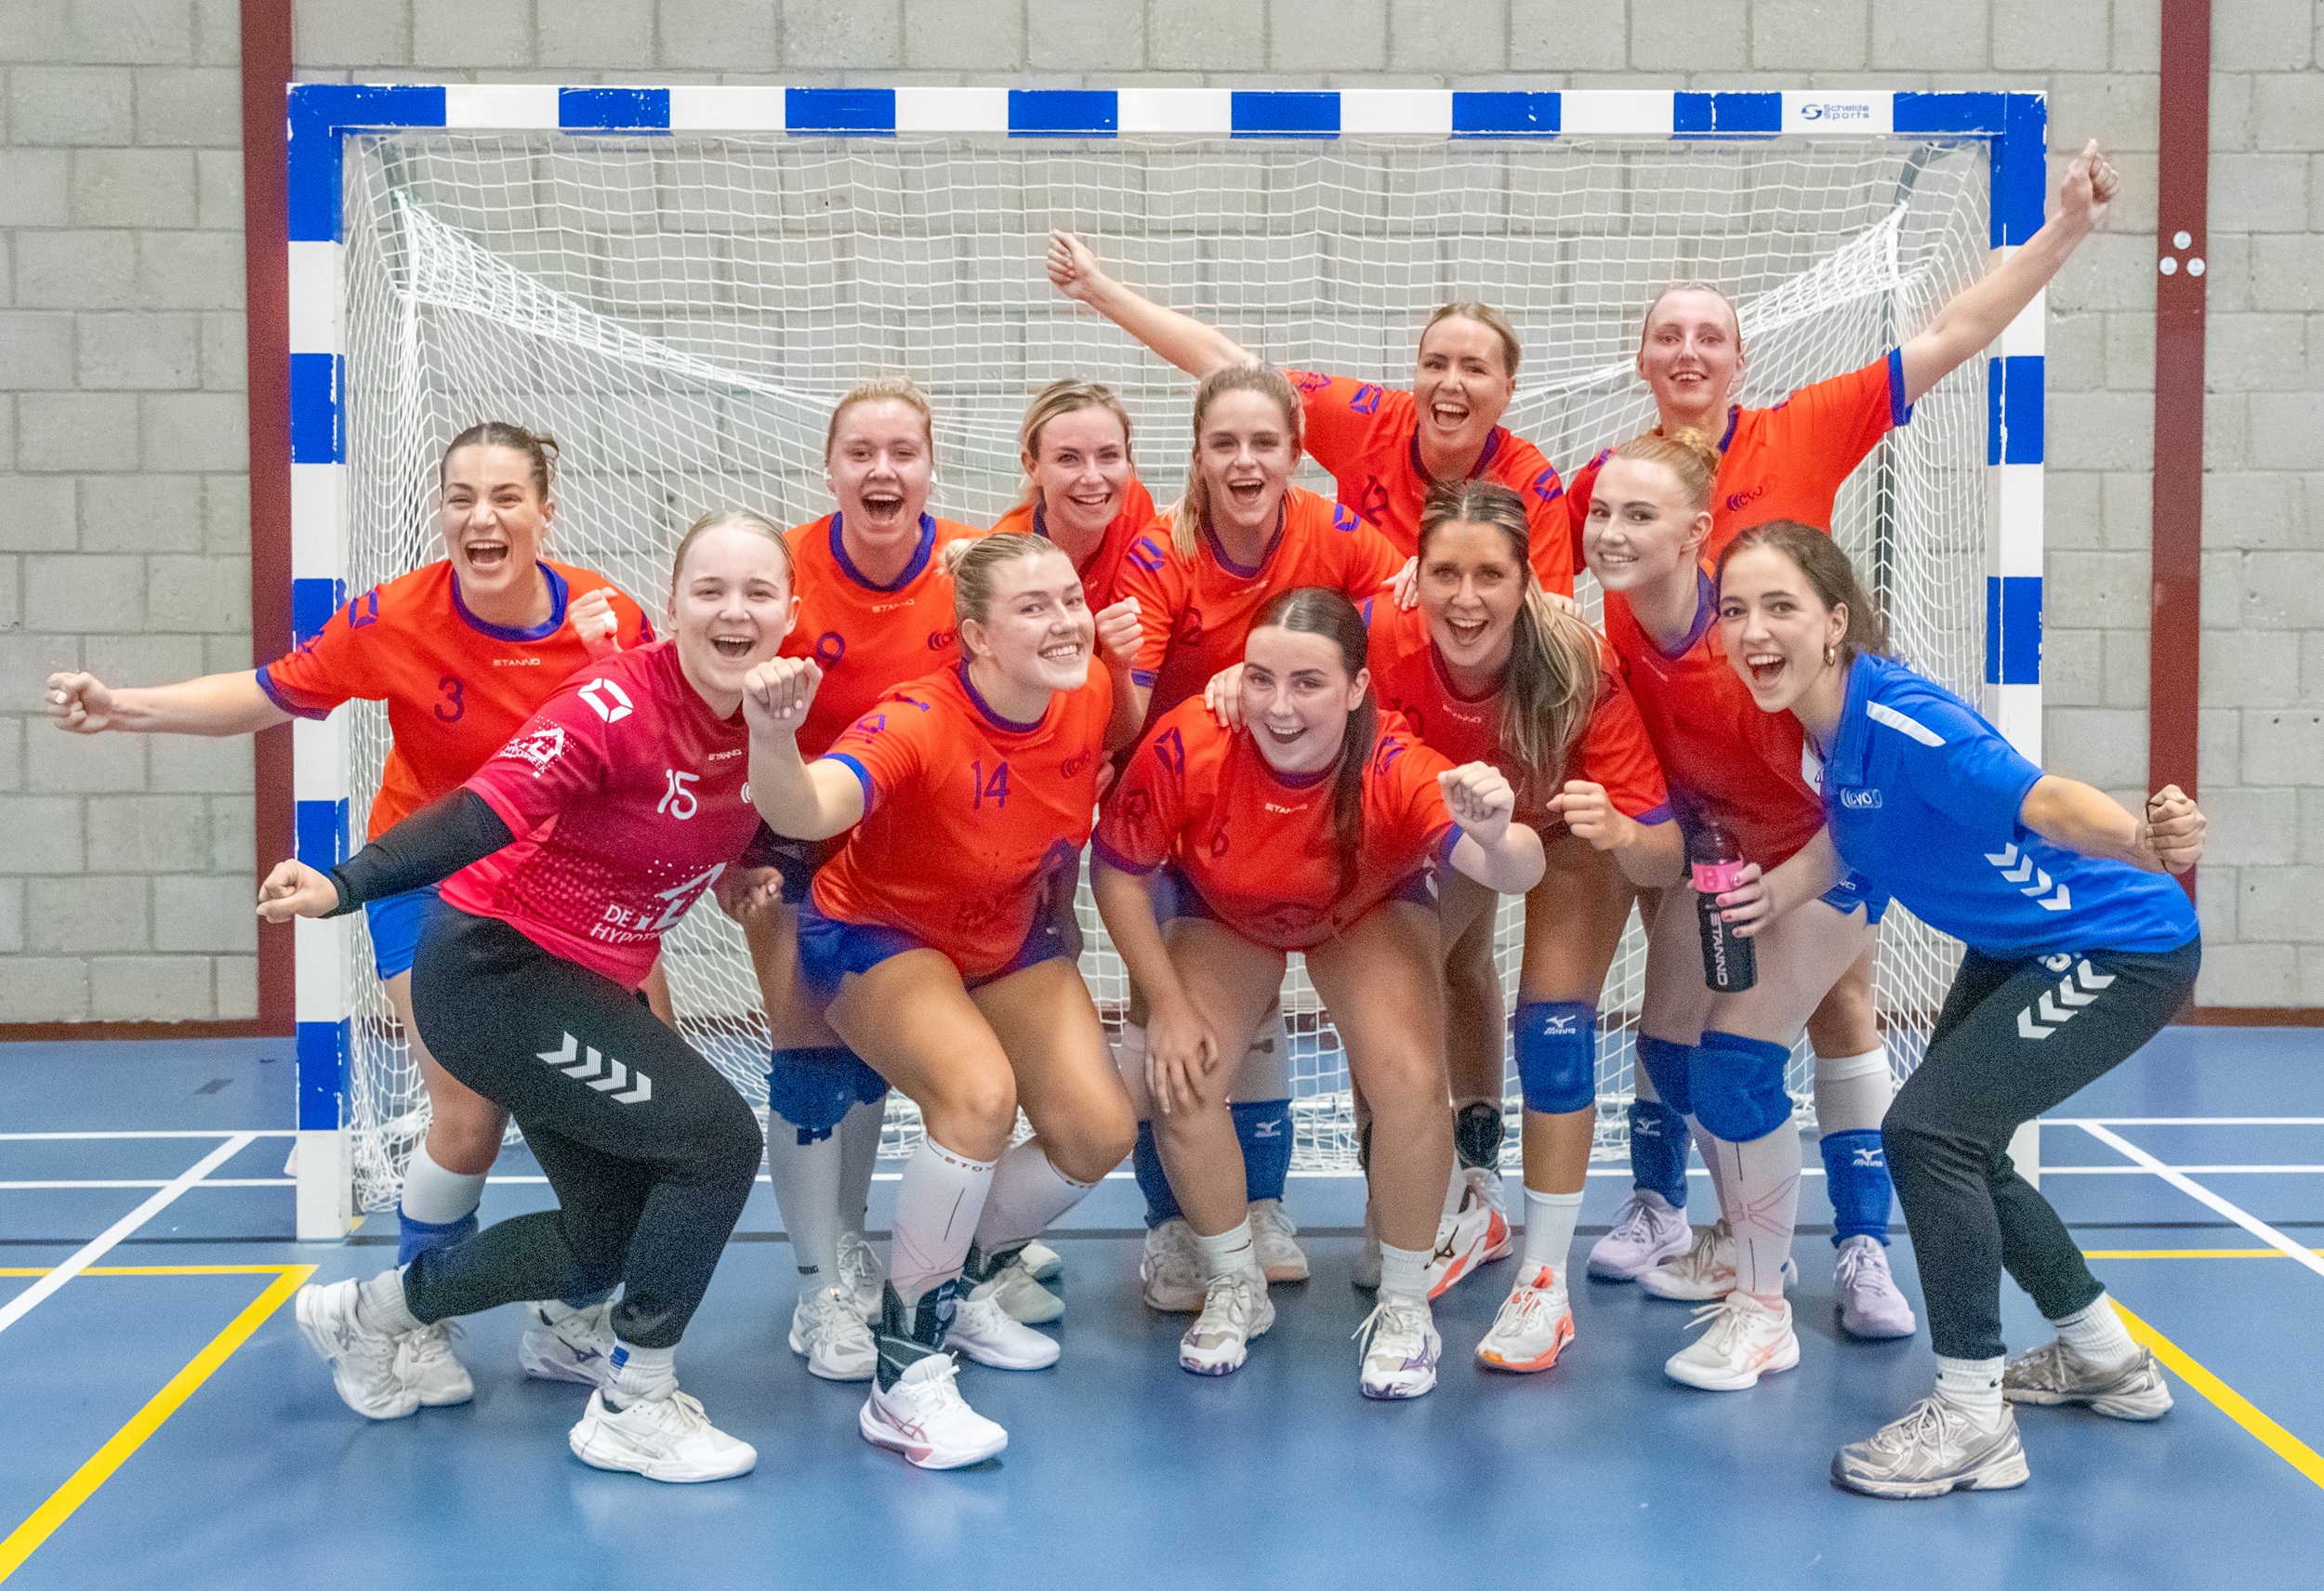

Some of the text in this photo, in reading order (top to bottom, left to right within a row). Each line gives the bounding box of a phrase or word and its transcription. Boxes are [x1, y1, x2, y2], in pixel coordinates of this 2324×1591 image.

[1823, 112, 1869, 121] Sports
[434, 677, 465, 723] 3
[657, 769, 700, 821] 15
[971, 760, 1011, 809] 14
[603, 903, 633, 927] DE
[1710, 913, 1728, 986] STANNO
